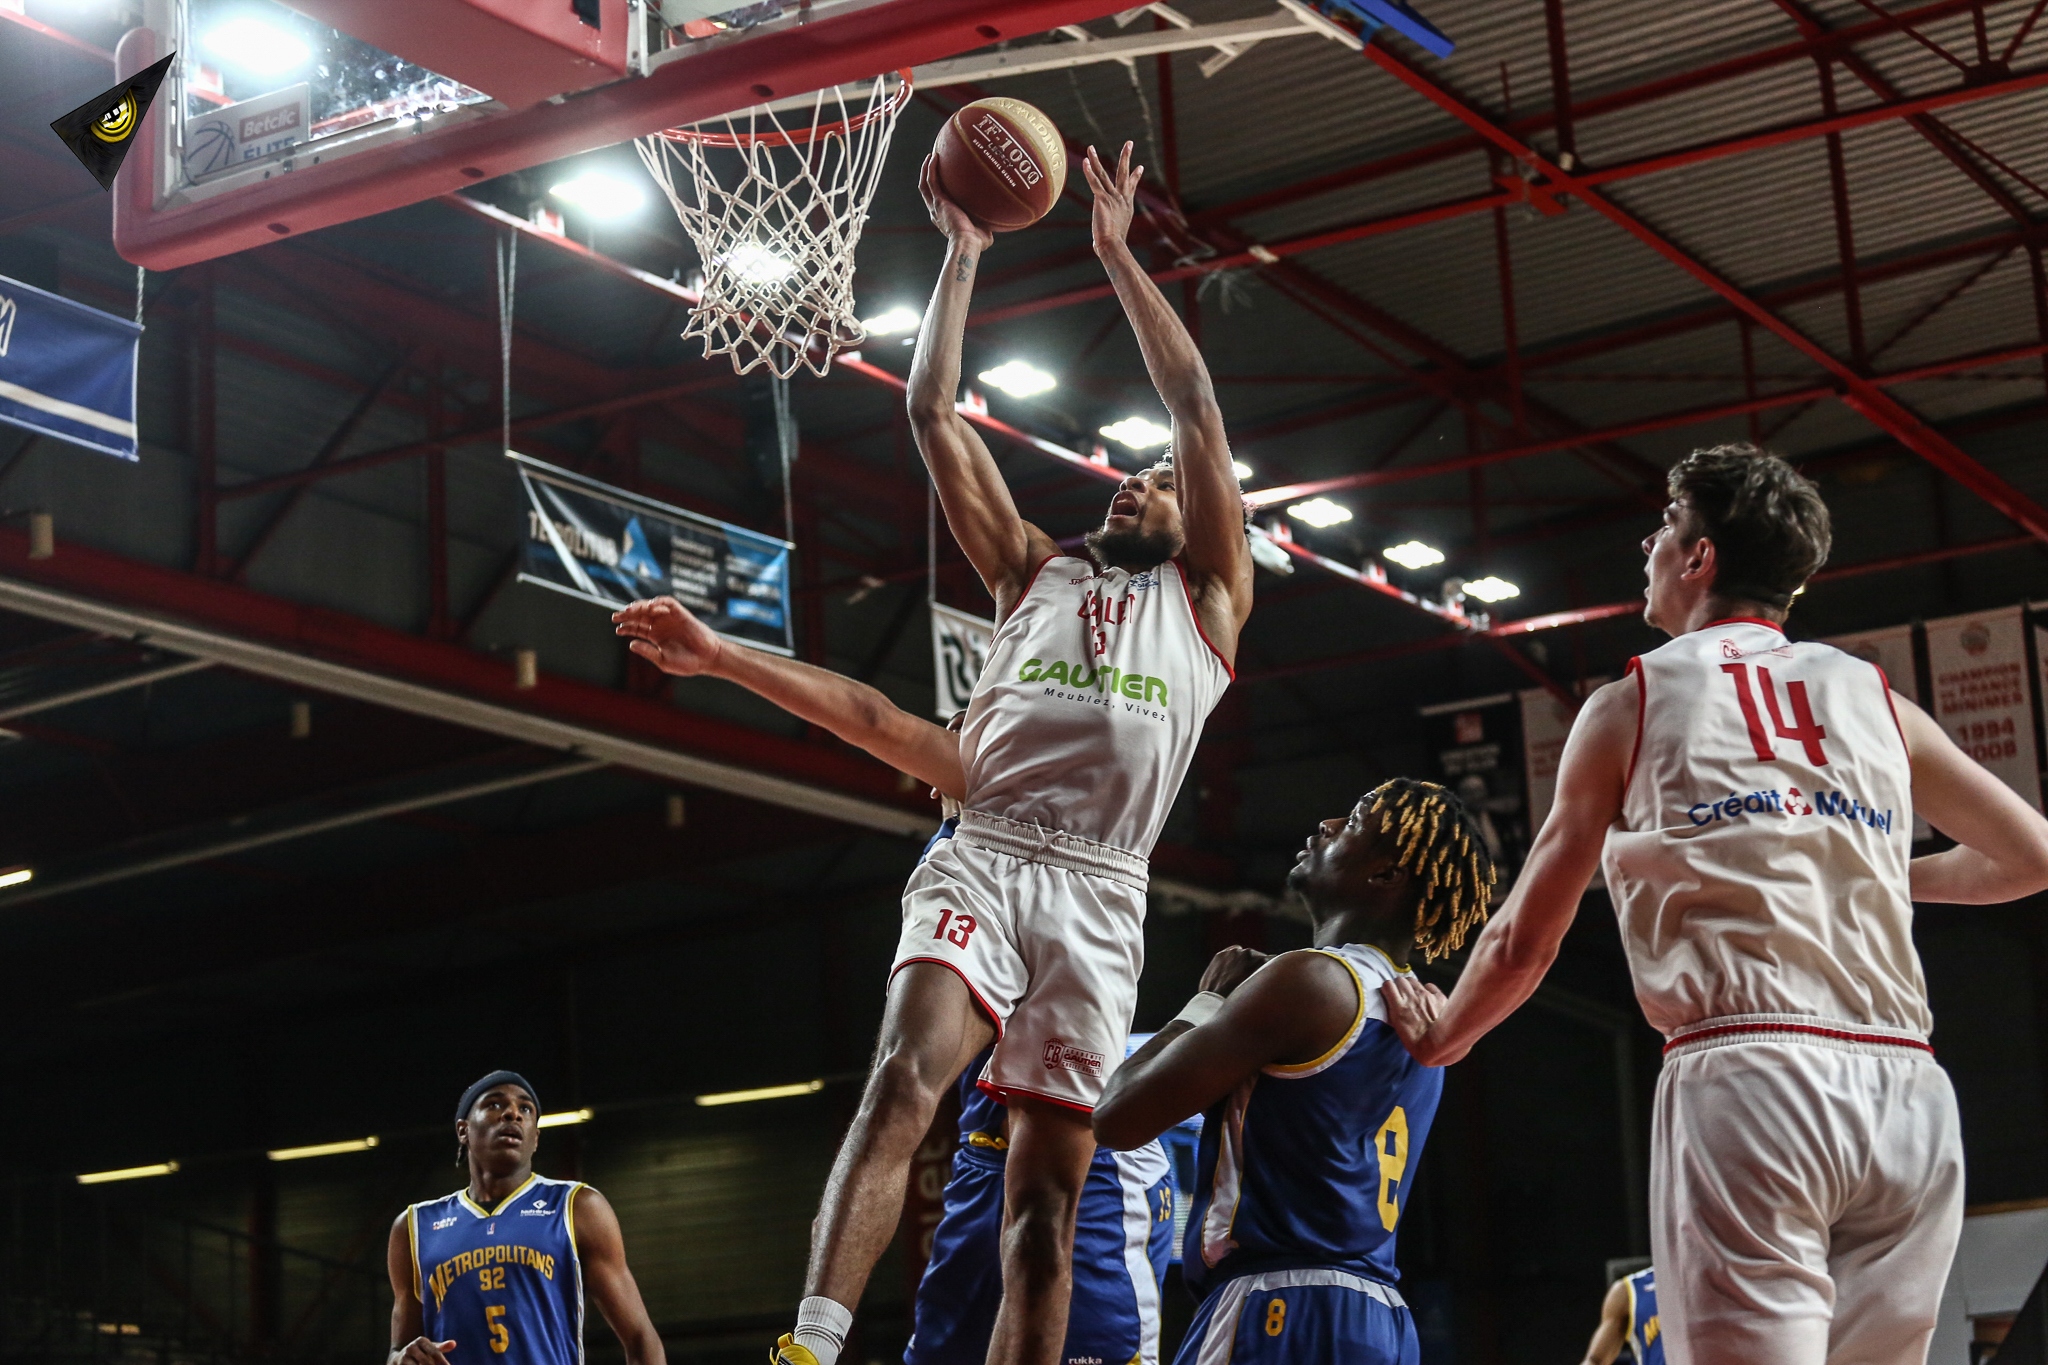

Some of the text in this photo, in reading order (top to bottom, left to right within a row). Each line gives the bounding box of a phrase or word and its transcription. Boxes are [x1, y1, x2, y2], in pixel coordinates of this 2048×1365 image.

[243, 108, 297, 139] Betclic
[976, 115, 1041, 185] TF-1000
[1019, 658, 1168, 708] GAUTIER
[1044, 687, 1166, 722] Meublez, Vivez
[1719, 662, 1829, 767] 14
[1687, 789, 1892, 835] Crédit Mutuel
[932, 908, 978, 951] 13
[1044, 1044, 1062, 1063] CB
[1373, 1104, 1410, 1234] 8
[428, 1244, 555, 1314] METROPOLITANS
[478, 1266, 506, 1292] 92
[485, 1304, 510, 1354] 5
[1264, 1297, 1287, 1337] 8
[1068, 1356, 1103, 1365] rukka
